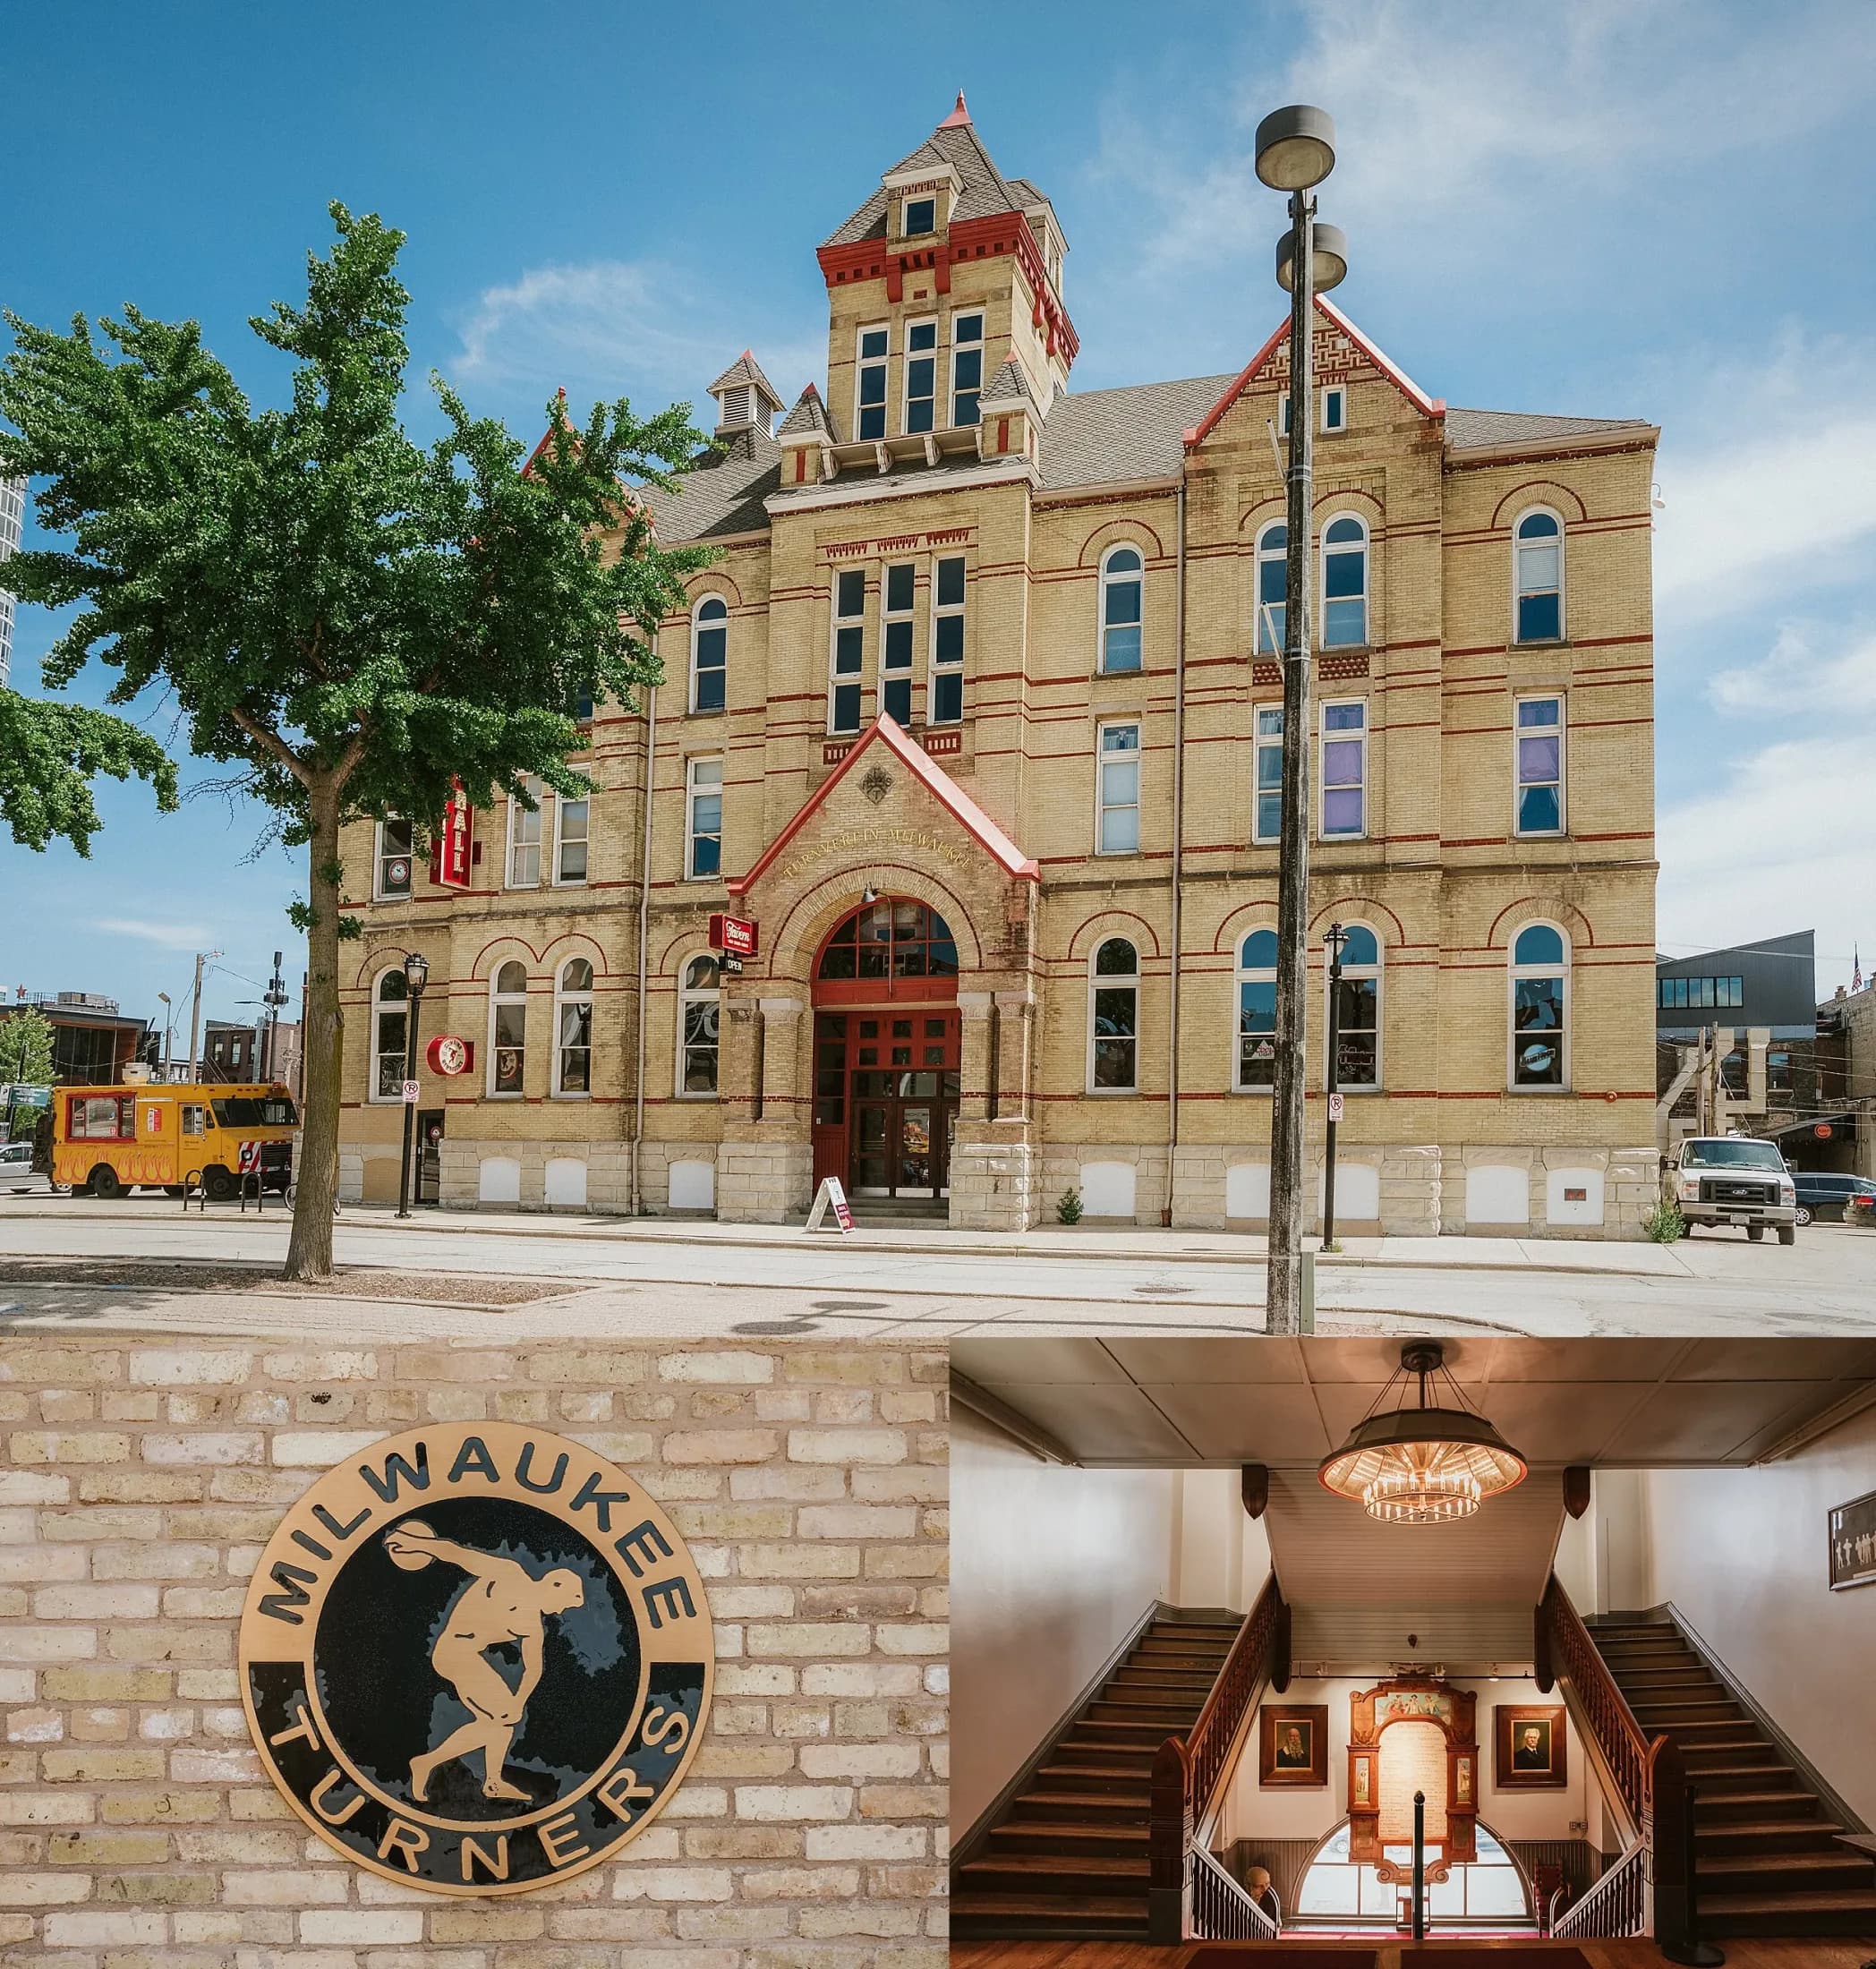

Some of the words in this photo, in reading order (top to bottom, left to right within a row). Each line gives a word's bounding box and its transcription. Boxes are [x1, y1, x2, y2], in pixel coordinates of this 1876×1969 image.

[783, 829, 880, 879] TURNVEREIN
[889, 829, 975, 871] MILWAUKEE
[726, 920, 750, 942] Tavern
[728, 959, 742, 971] OPEN
[259, 1436, 697, 1629] MILWAUKEE
[270, 1703, 690, 1880] TURNERS
